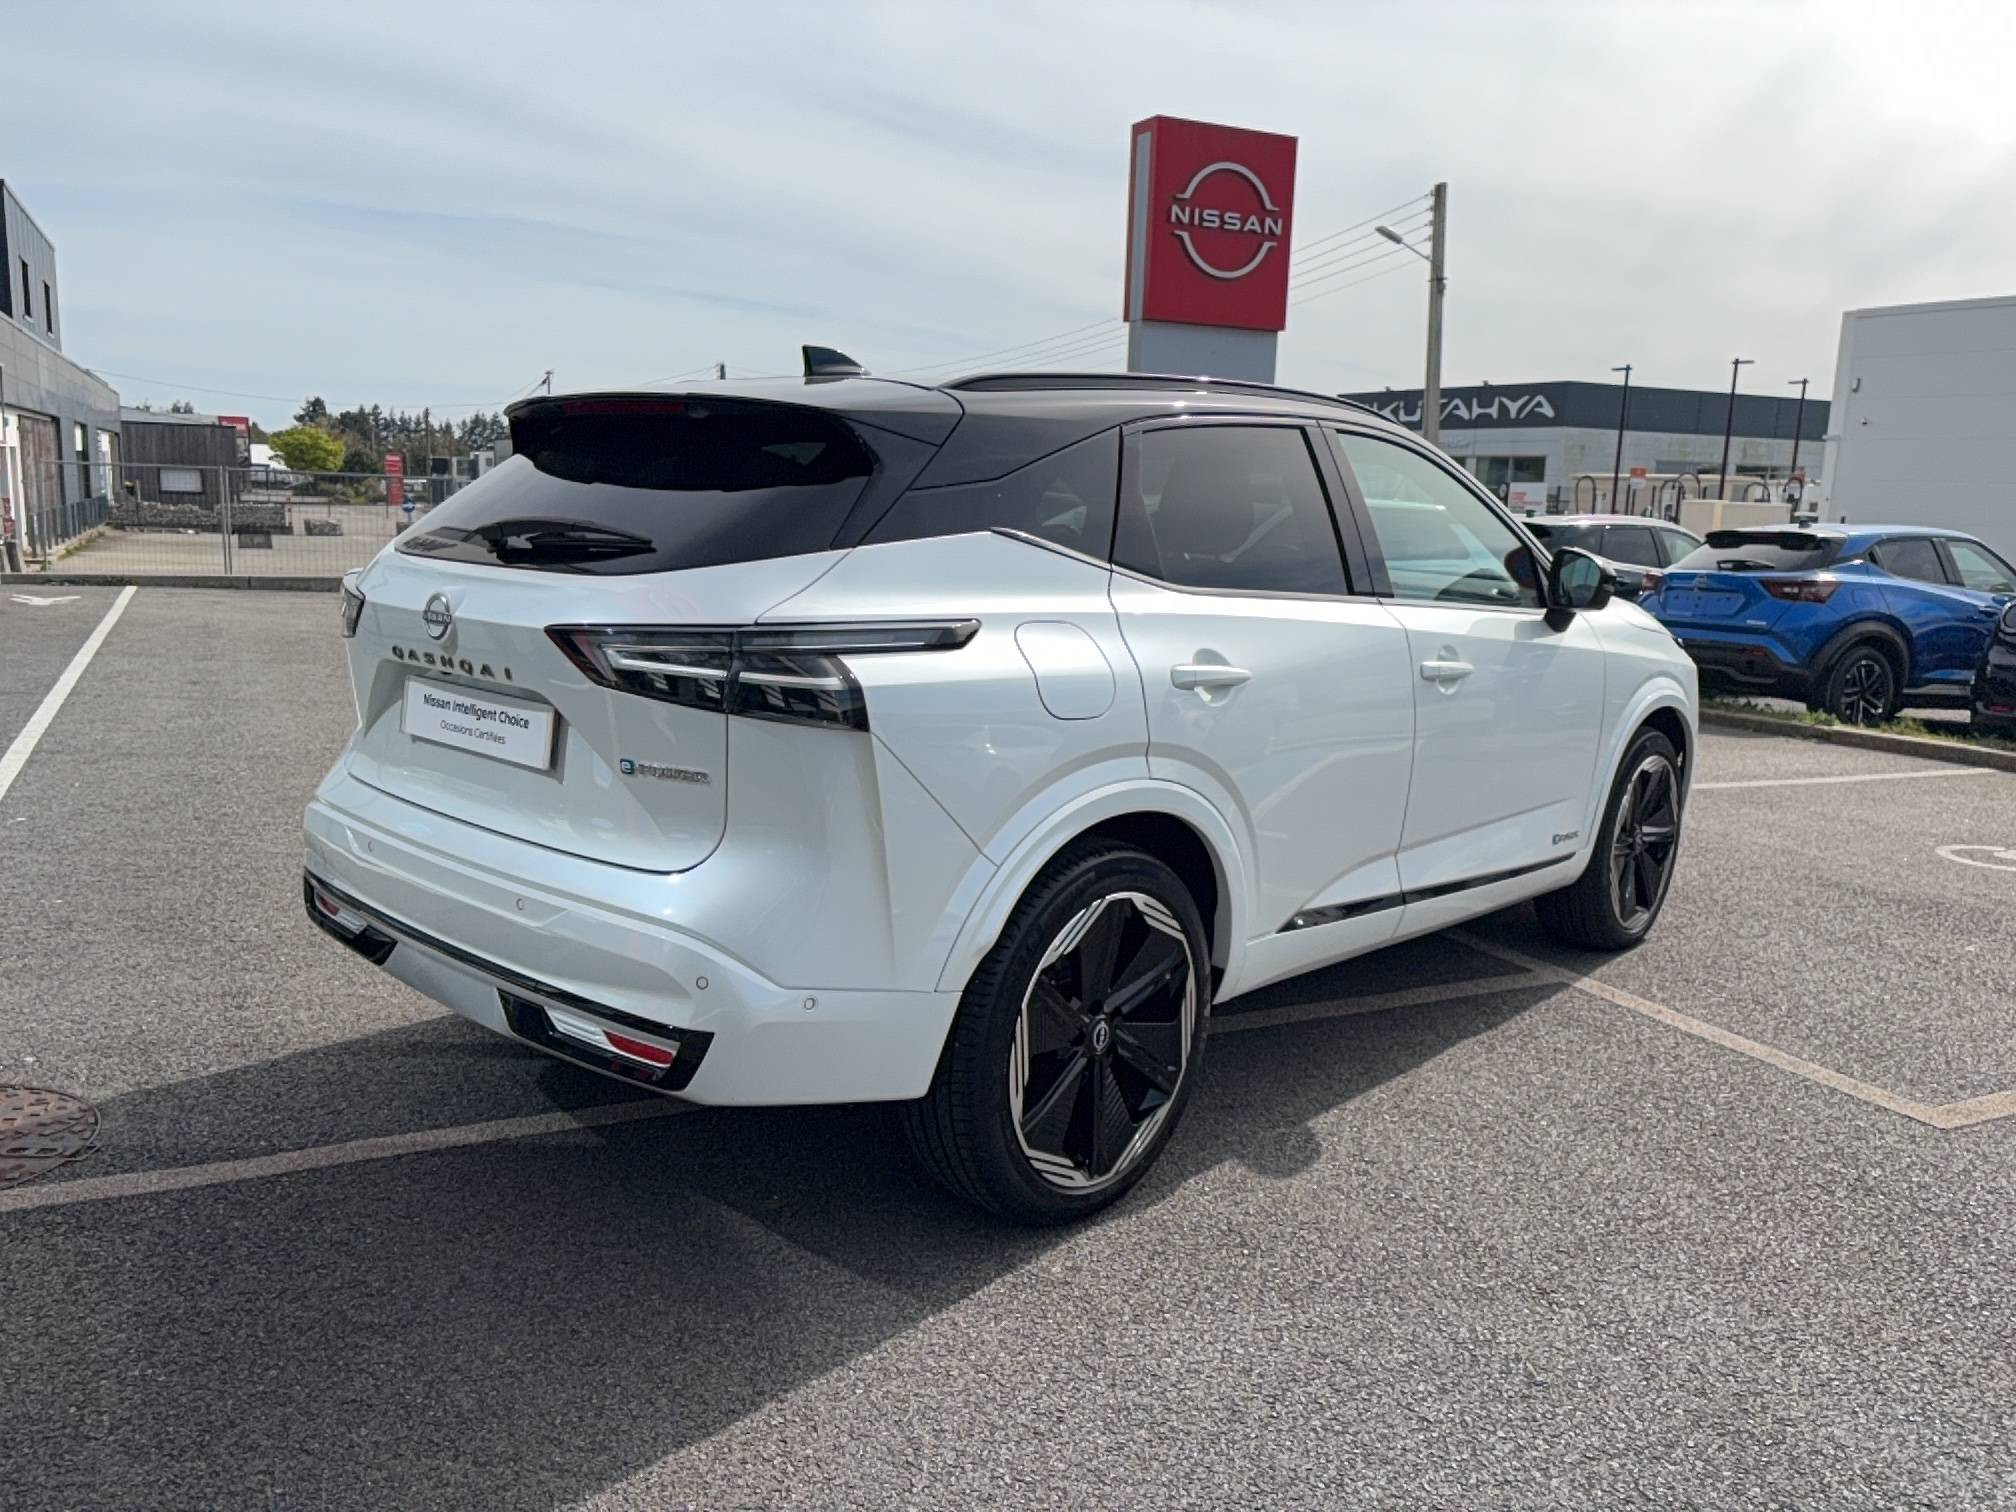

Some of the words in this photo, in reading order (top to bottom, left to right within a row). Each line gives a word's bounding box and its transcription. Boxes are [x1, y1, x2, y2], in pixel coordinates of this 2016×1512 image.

[1171, 204, 1283, 236] NISSAN
[392, 645, 513, 681] QASHQAI
[423, 693, 451, 711] Nissan
[452, 700, 497, 722] Intelligent
[498, 711, 530, 729] Choice
[440, 720, 474, 736] Occasions
